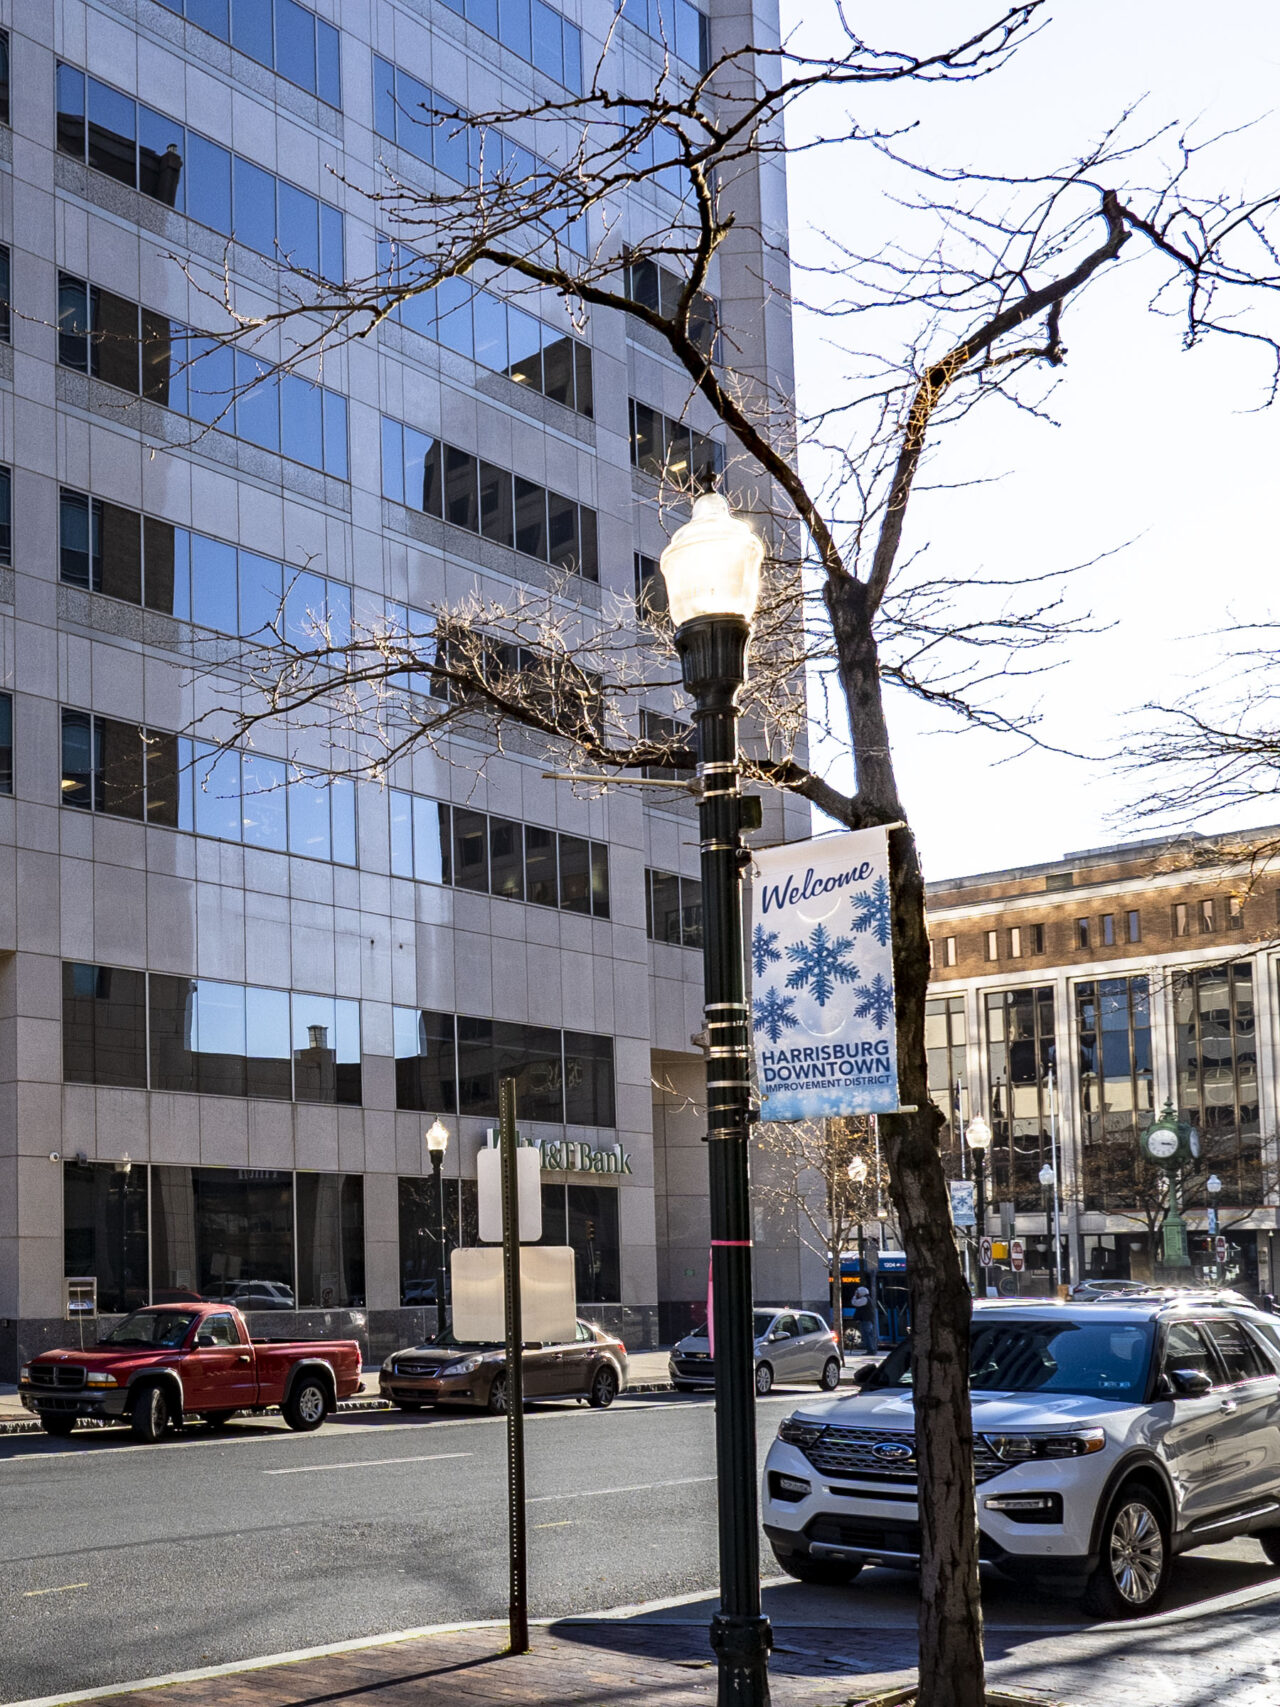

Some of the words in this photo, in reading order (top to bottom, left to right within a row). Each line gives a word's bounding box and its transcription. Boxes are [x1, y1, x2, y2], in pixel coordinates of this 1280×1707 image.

[762, 861, 874, 914] Welcome
[762, 1040, 889, 1066] HARRISBURG
[763, 1057, 891, 1082] DOWNTOWN
[765, 1078, 842, 1093] IMPROVEMENT
[844, 1075, 891, 1087] DISTRICT
[577, 1141, 633, 1174] Bank
